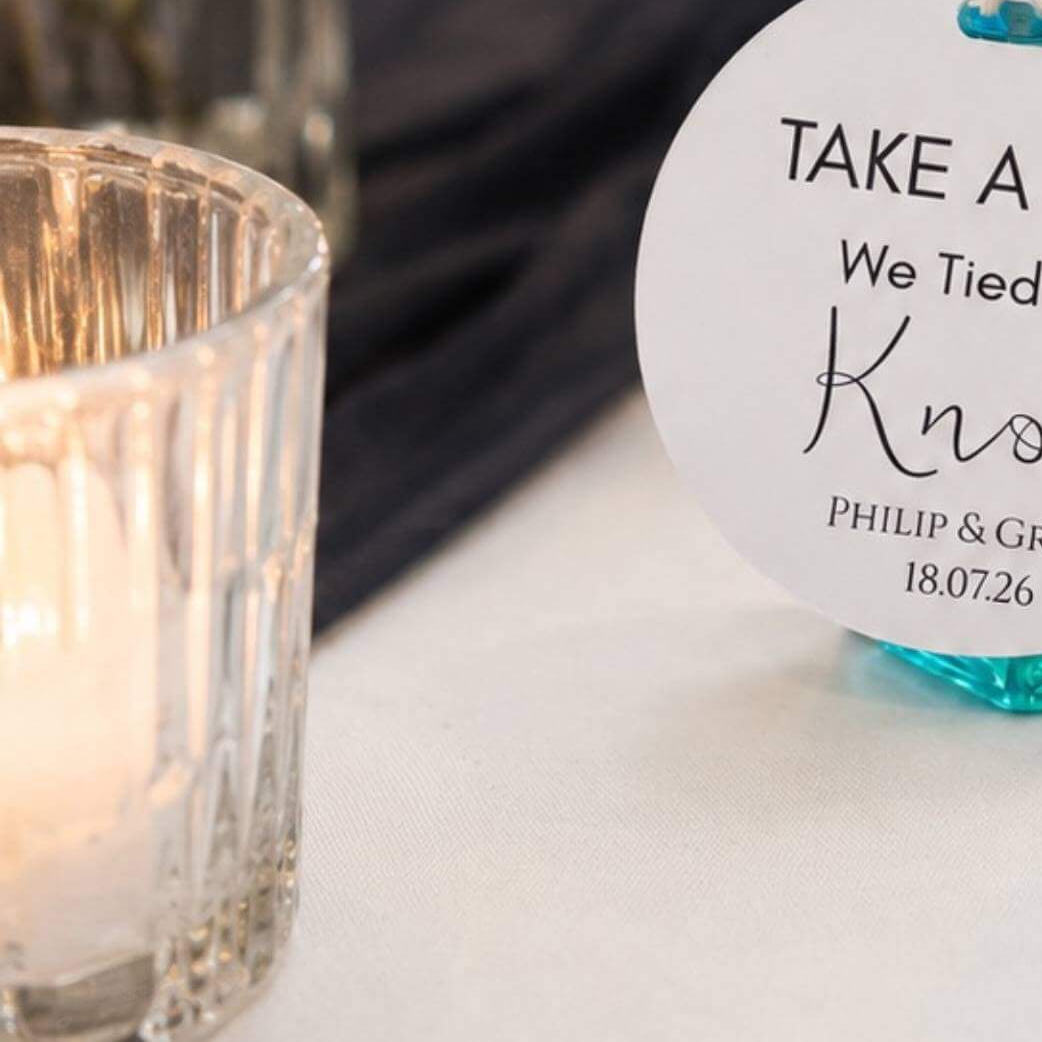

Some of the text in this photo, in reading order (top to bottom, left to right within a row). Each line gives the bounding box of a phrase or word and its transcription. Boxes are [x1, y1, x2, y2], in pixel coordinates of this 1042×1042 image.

[781, 118, 952, 199] TAKE
[977, 145, 1028, 210] A
[841, 240, 916, 289] We
[939, 253, 1042, 306] Tied
[828, 496, 948, 539] PHILIP
[957, 512, 987, 545] &
[904, 561, 1035, 606] 18.07.26
